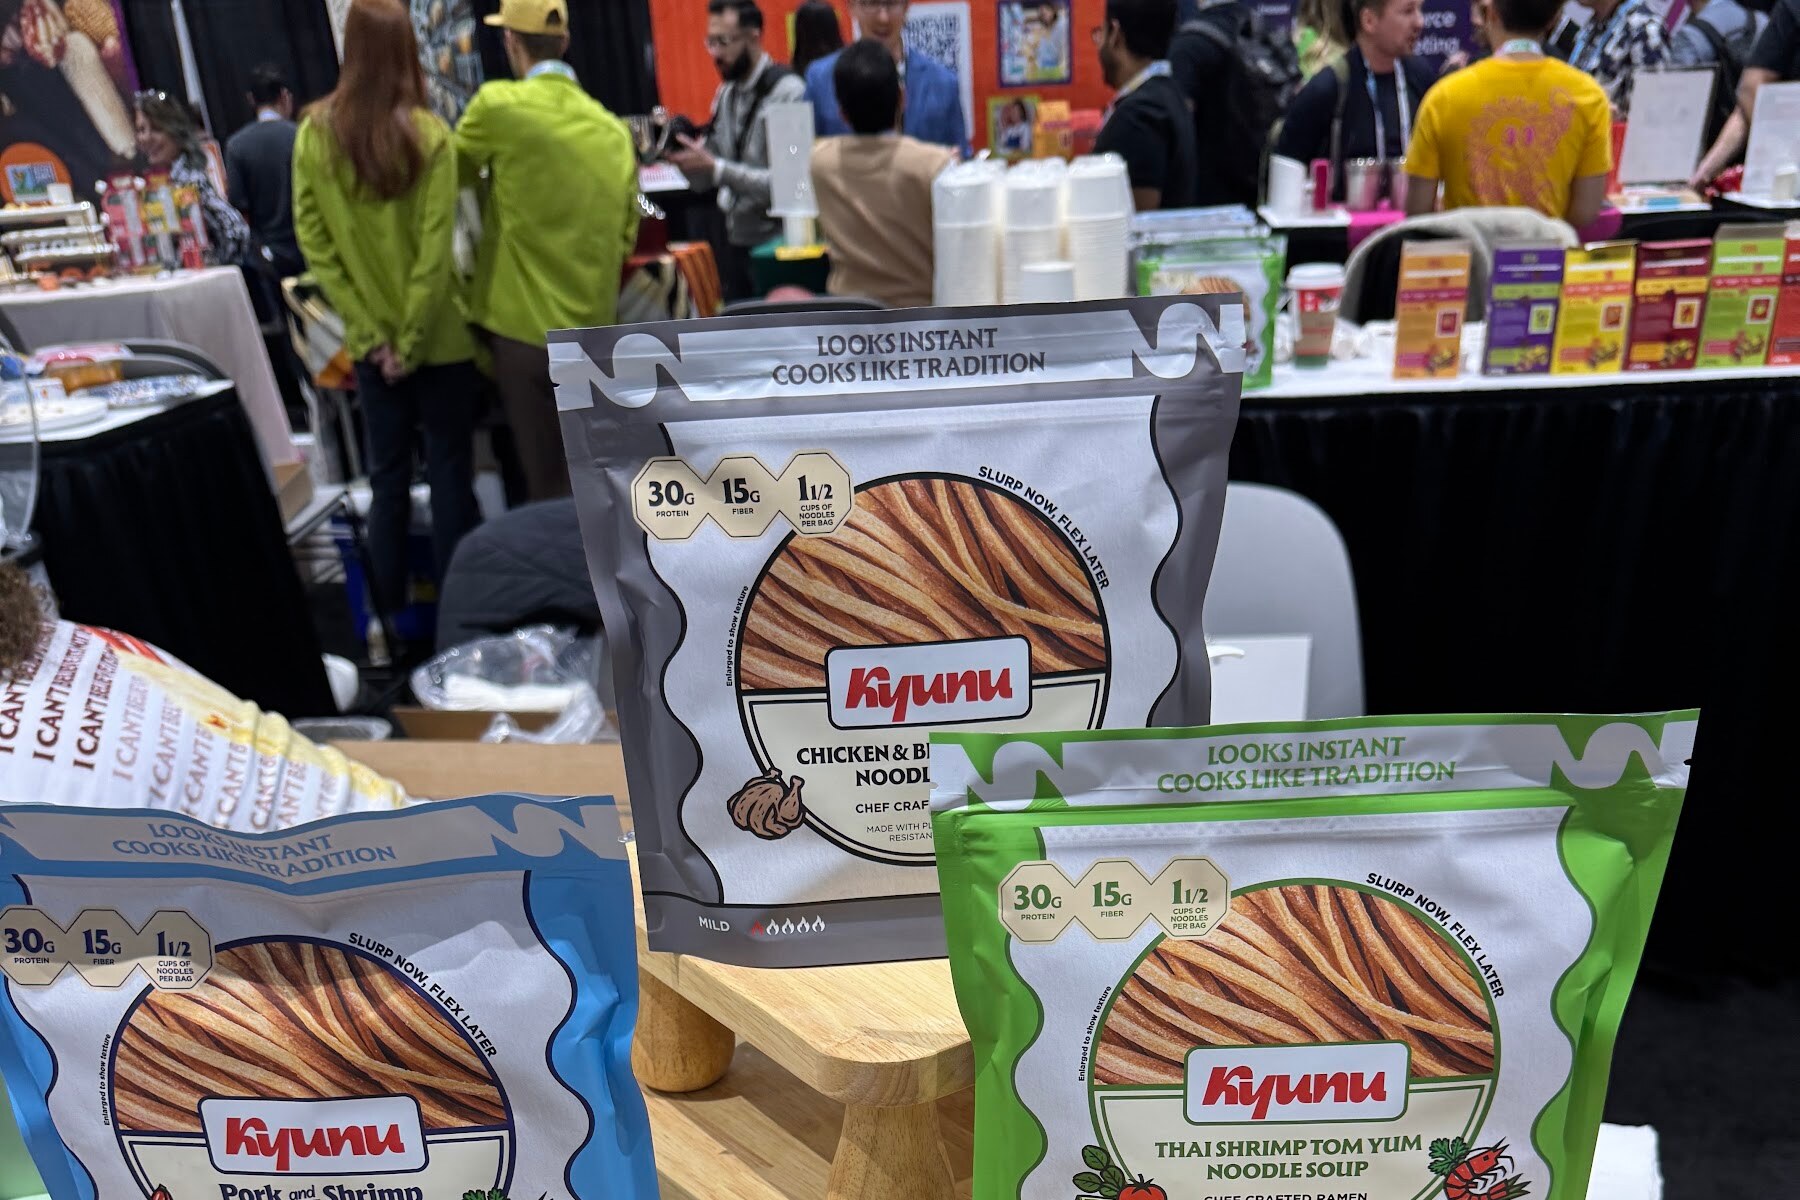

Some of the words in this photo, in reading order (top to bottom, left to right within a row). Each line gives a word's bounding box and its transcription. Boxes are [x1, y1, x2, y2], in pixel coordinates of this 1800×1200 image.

[817, 333, 896, 357] LOOKS
[900, 327, 998, 352] INSTANT
[772, 362, 856, 386] COOKS
[861, 359, 910, 382] LIKE
[913, 351, 1046, 378] TRADITION
[656, 510, 690, 518] PROTEIN
[799, 511, 835, 520] NOODLES
[801, 520, 817, 528] PER
[818, 519, 834, 527] BAG
[978, 466, 1024, 491] SLURP
[1057, 514, 1087, 548] FLEX
[1082, 546, 1110, 590] LATER
[734, 585, 749, 614] texture
[729, 615, 739, 638] show
[728, 638, 734, 648] to
[725, 650, 734, 687] Enlarged
[845, 666, 1013, 723] Kyunu
[796, 745, 890, 766] CHICKEN
[892, 745, 910, 761] &
[1208, 742, 1293, 765] LOOKS
[1297, 736, 1406, 761] INSTANT
[1157, 770, 1247, 793] COOKS
[1250, 767, 1306, 789] LIKE
[1310, 761, 1456, 787] TRADITION
[855, 802, 890, 814] CHEF
[893, 800, 929, 813] CRAF
[866, 824, 894, 833] MADE
[895, 823, 924, 832] WITH
[147, 823, 229, 849] LOOKS
[228, 833, 332, 861] INSTANT
[112, 839, 201, 857] COOKS
[200, 844, 250, 867] LIKE
[252, 846, 397, 878] TRADITION
[1021, 913, 1055, 921] PROTEIN
[1100, 910, 1124, 918] FIBER
[1170, 914, 1208, 922] NOODLES
[1172, 907, 1192, 915] CUPS
[698, 916, 730, 932] MILD
[1190, 922, 1206, 930] BAG
[1366, 872, 1415, 898] SLURP
[1415, 894, 1451, 927] NOW,
[1450, 921, 1482, 956] FLEX
[1476, 954, 1505, 999] LATER
[93, 958, 115, 966] FIBER
[156, 967, 194, 975] NOODLES
[349, 932, 394, 959] SLURP
[394, 954, 429, 988] NOW,
[429, 983, 465, 1016] FLEX
[461, 1015, 498, 1058] LATER
[1094, 986, 1112, 1013] texture
[1087, 1014, 1098, 1036] show
[1083, 1036, 1091, 1045] to
[1078, 1046, 1089, 1082] Enlarged
[1202, 1065, 1387, 1120] Kyunu
[226, 1117, 406, 1171] Kyunu
[1154, 1141, 1211, 1158] THAI
[1215, 1139, 1307, 1157] SHRIMP
[1310, 1138, 1364, 1156] TOM
[1367, 1134, 1422, 1153] YUM
[1206, 1162, 1302, 1180] NOODLE
[1306, 1160, 1369, 1178] SOUP
